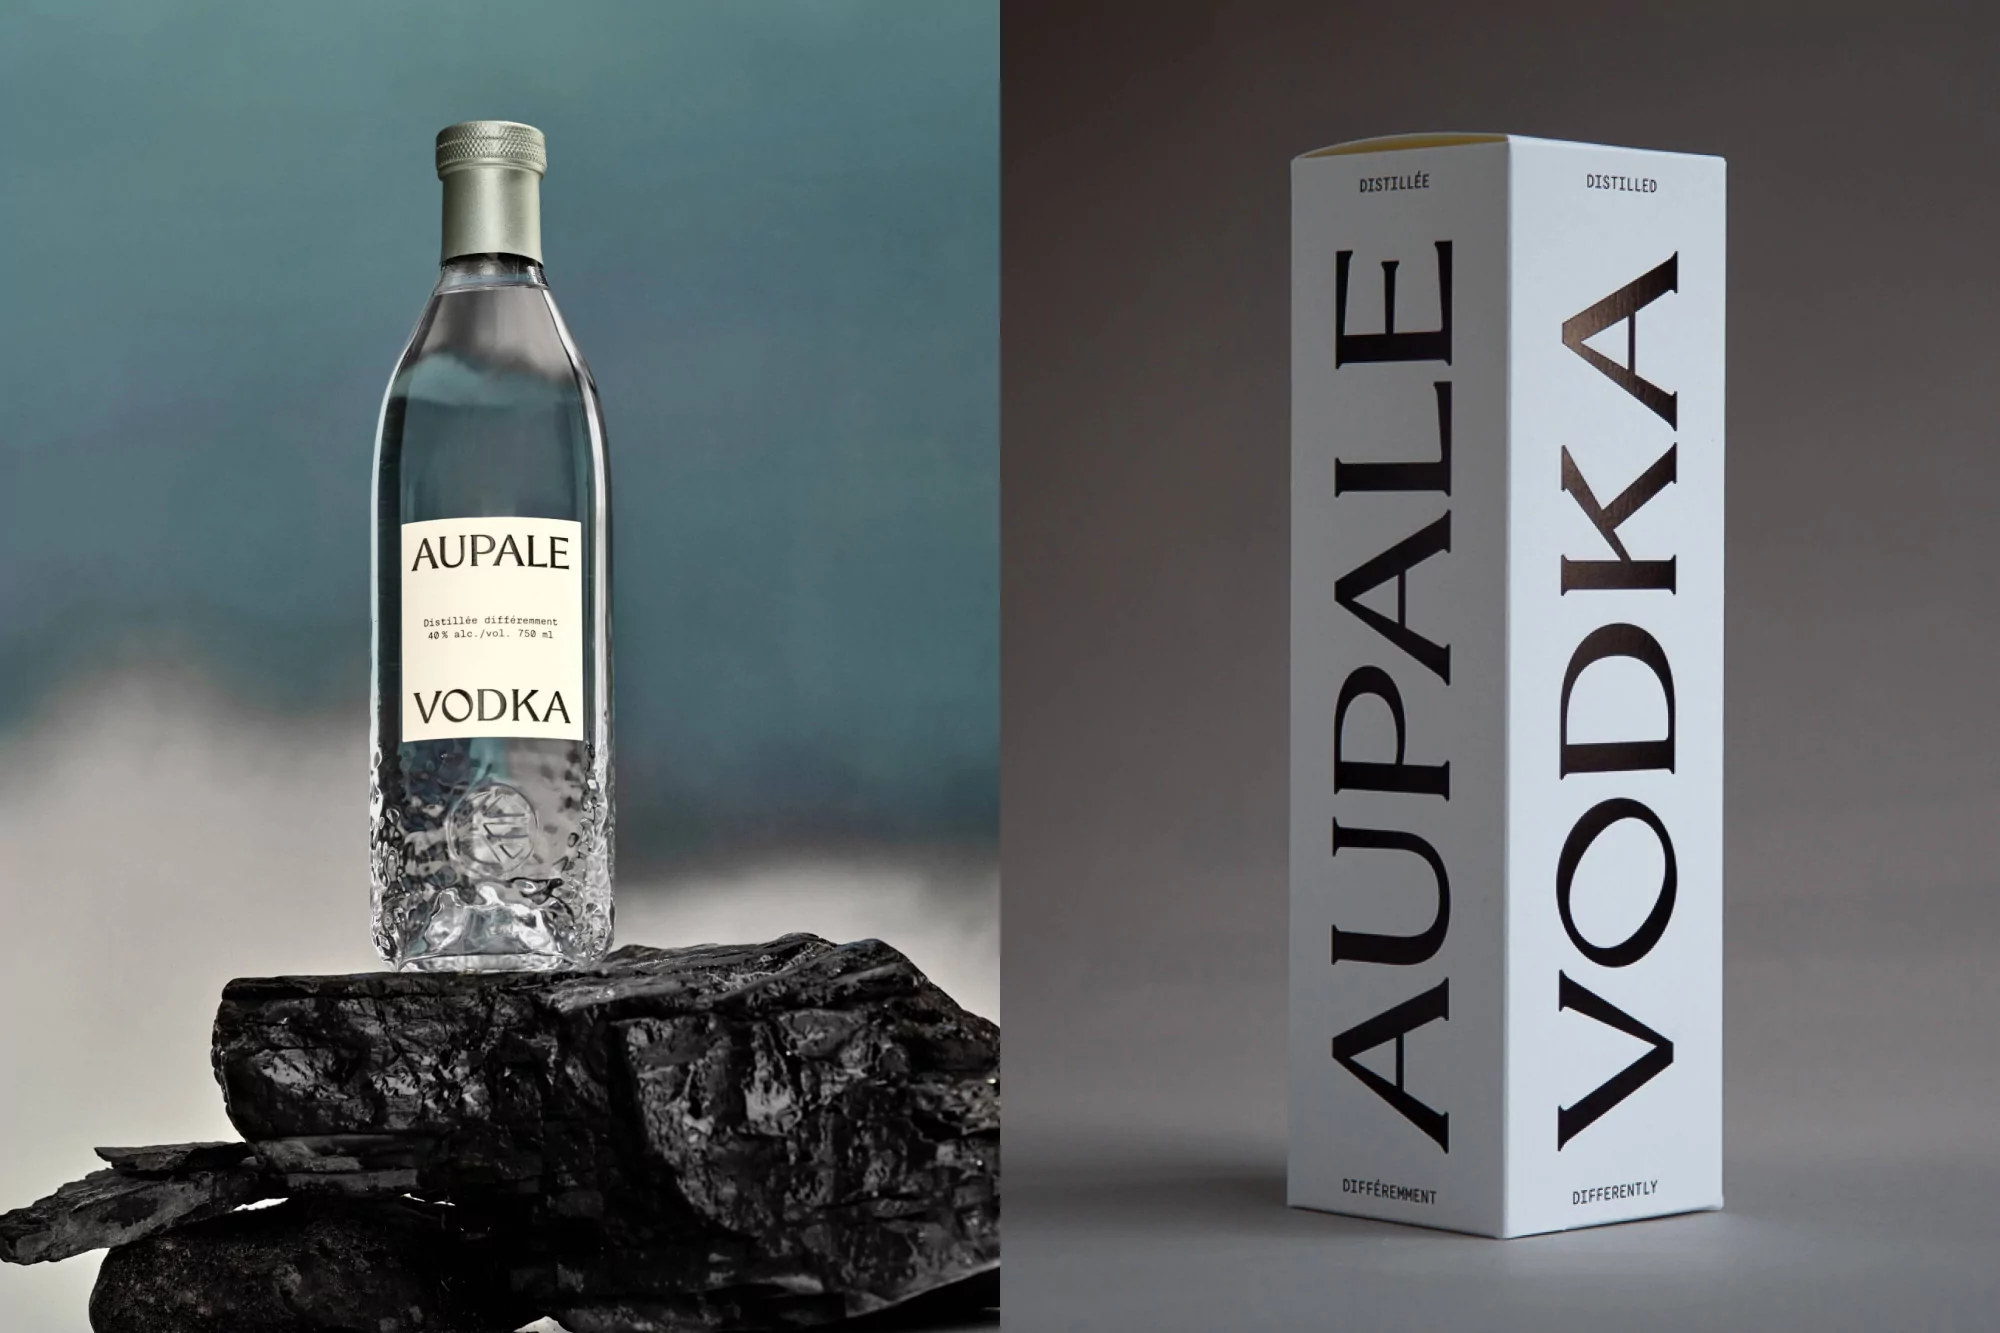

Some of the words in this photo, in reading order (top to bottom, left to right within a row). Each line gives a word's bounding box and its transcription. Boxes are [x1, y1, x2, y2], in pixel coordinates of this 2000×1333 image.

[1359, 171, 1431, 194] DISTILLÉE
[1586, 174, 1658, 194] DISTILLED
[411, 534, 570, 572] AUPALE
[423, 615, 478, 628] Distillée
[484, 614, 558, 627] différemment
[454, 629, 510, 640] alc./vol.
[518, 629, 537, 638] 750
[542, 630, 554, 639] ml
[413, 688, 571, 724] VODKA
[1331, 240, 1453, 1155] AUPALE
[1556, 250, 1679, 1153] VODKA
[1342, 1178, 1437, 1206] DIFFÉREMMENT
[1572, 1179, 1659, 1206] DIFFERENTLY
